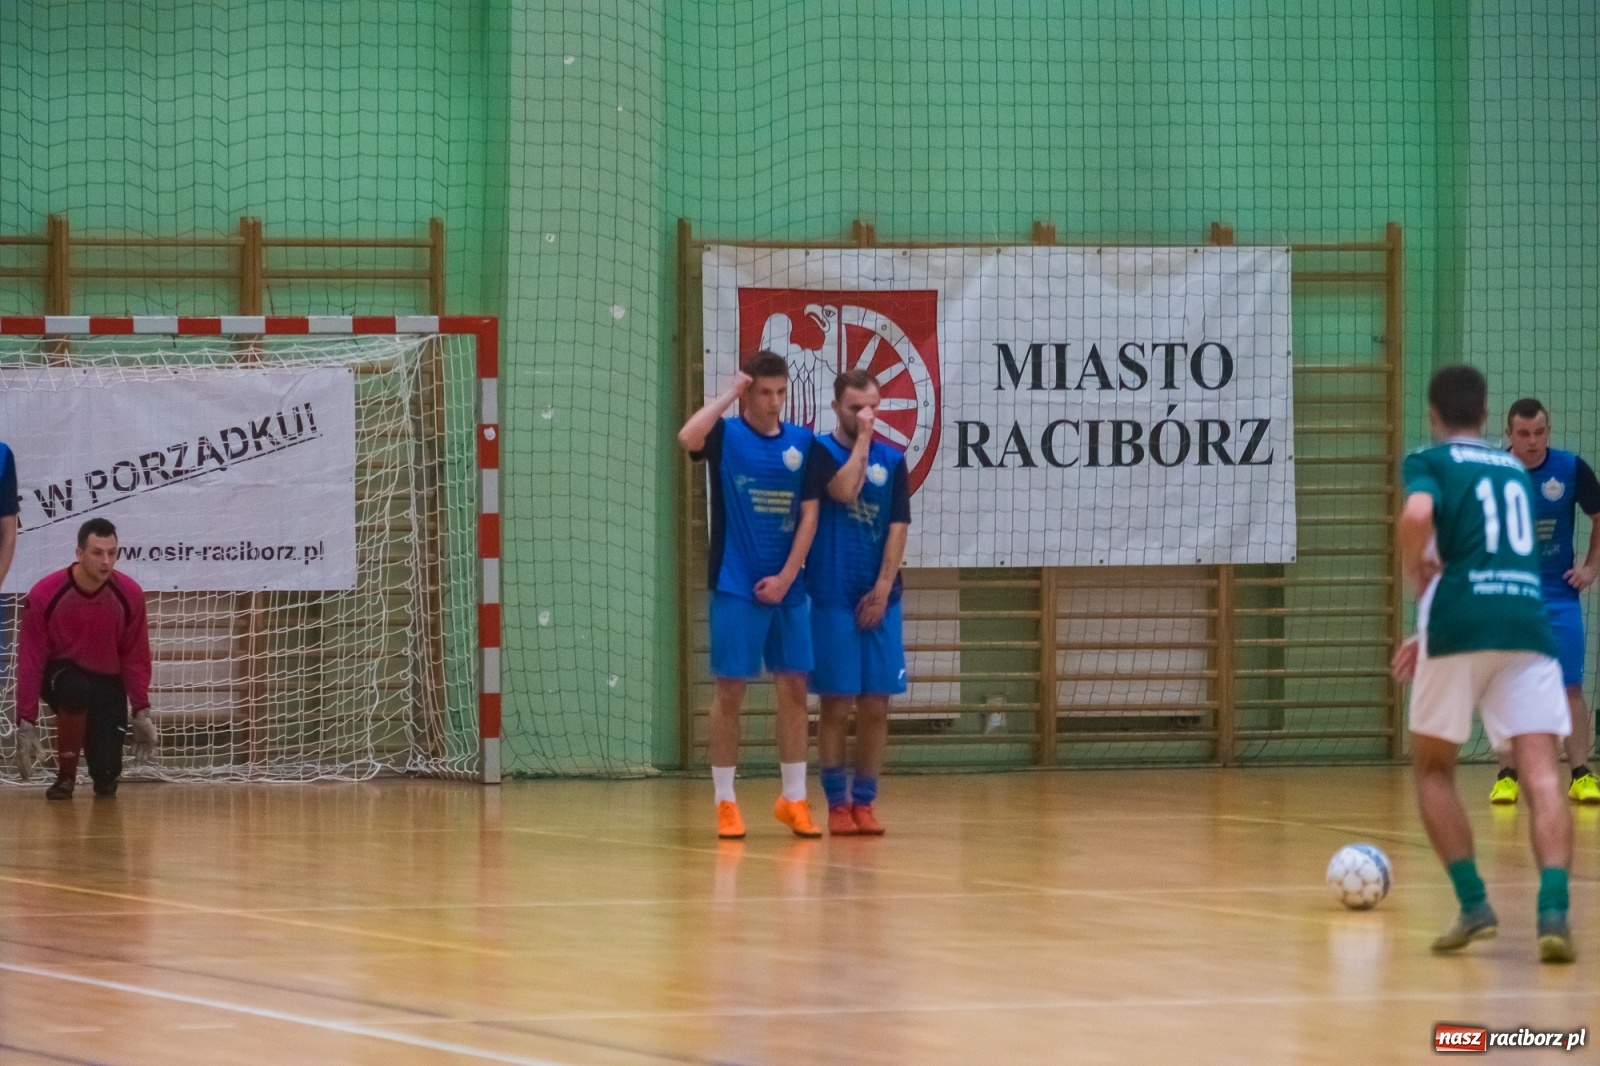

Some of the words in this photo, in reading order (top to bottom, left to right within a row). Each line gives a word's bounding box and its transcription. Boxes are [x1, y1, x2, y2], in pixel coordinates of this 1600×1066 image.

[992, 342, 1234, 391] MIASTO
[953, 404, 1274, 468] RACIBÓRZ
[34, 479, 73, 518] W
[1475, 477, 1534, 556] 10
